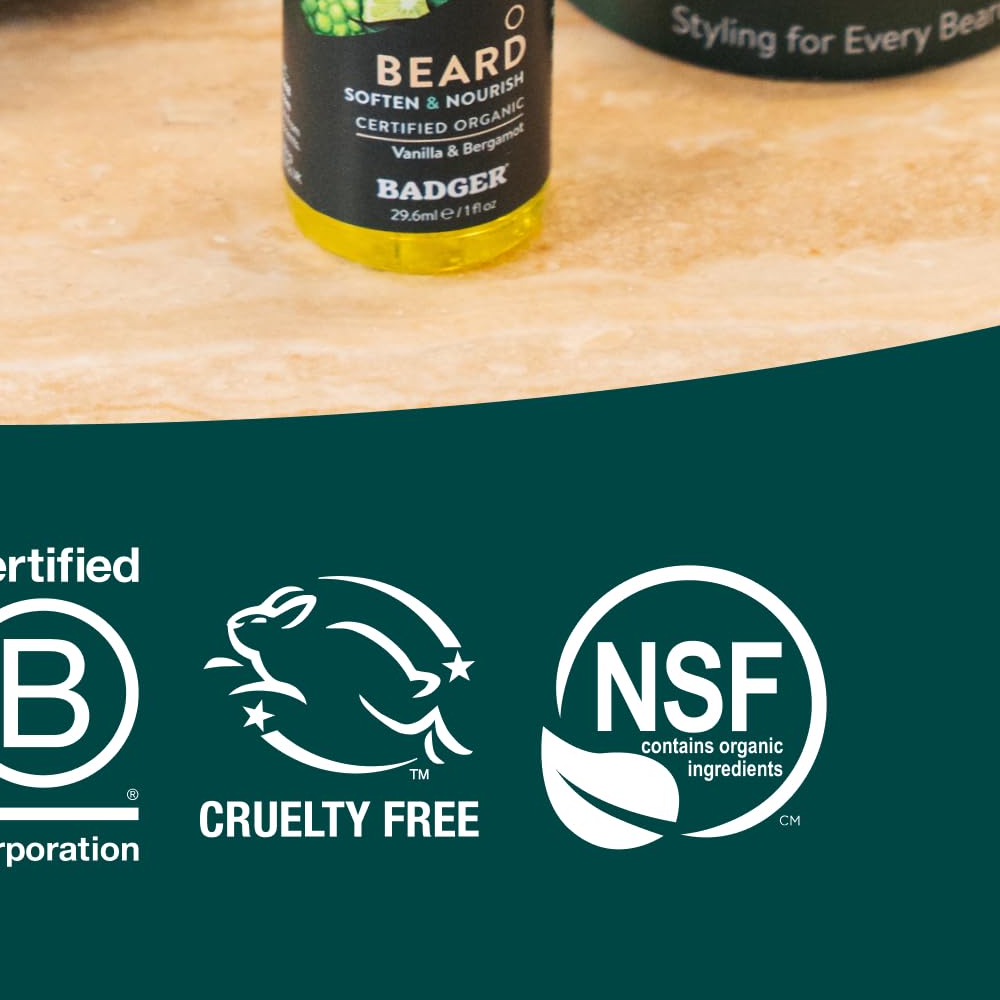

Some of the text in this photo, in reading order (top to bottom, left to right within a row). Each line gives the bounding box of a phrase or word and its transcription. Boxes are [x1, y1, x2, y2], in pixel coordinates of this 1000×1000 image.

[671, 1, 1000, 59] Styling for Every Bear
[376, 34, 527, 88] BEARD
[344, 70, 525, 111] SOFTEN & NOURISH
[355, 96, 525, 135] CERTIFIED ORGANIC
[391, 122, 525, 160] Vanilla & Bergamot
[376, 165, 508, 201] BADGER
